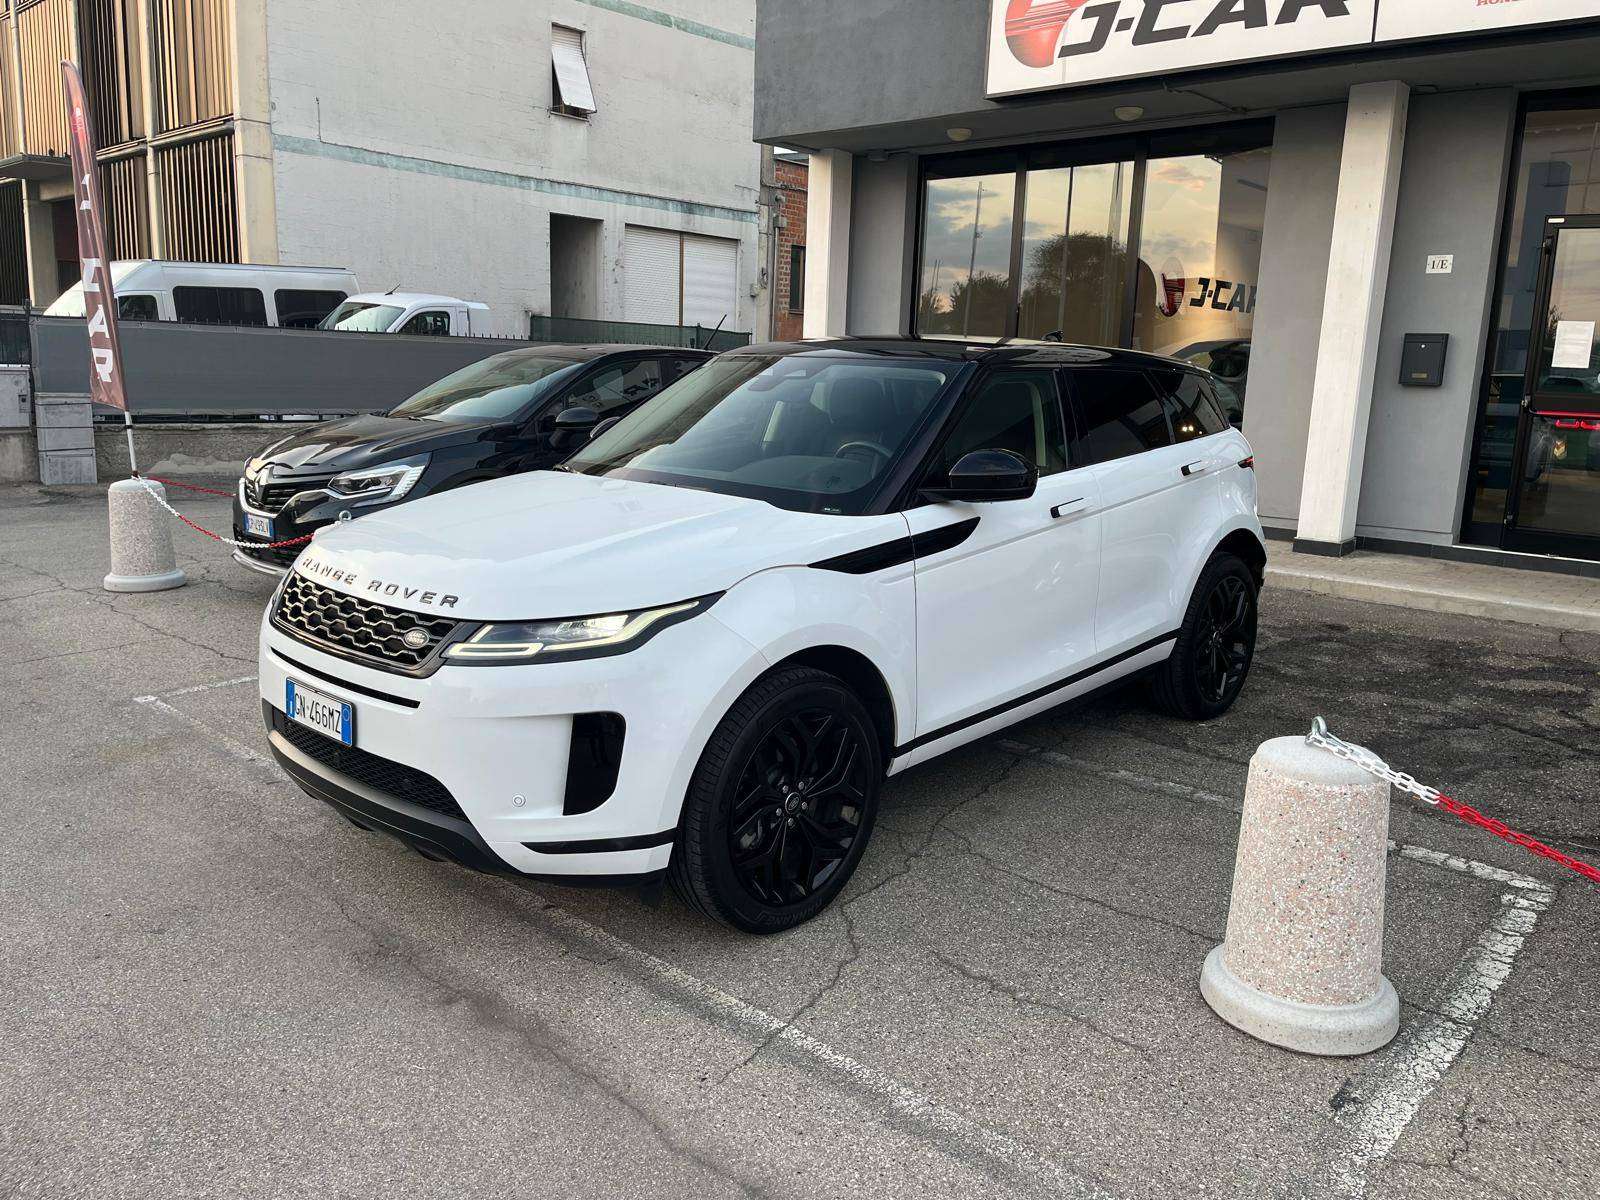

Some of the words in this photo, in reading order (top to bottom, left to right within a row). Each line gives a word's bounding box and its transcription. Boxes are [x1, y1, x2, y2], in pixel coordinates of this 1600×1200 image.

[1431, 259, 1448, 270] 1/E
[302, 557, 357, 585] RANGE
[367, 579, 460, 609] ROVER
